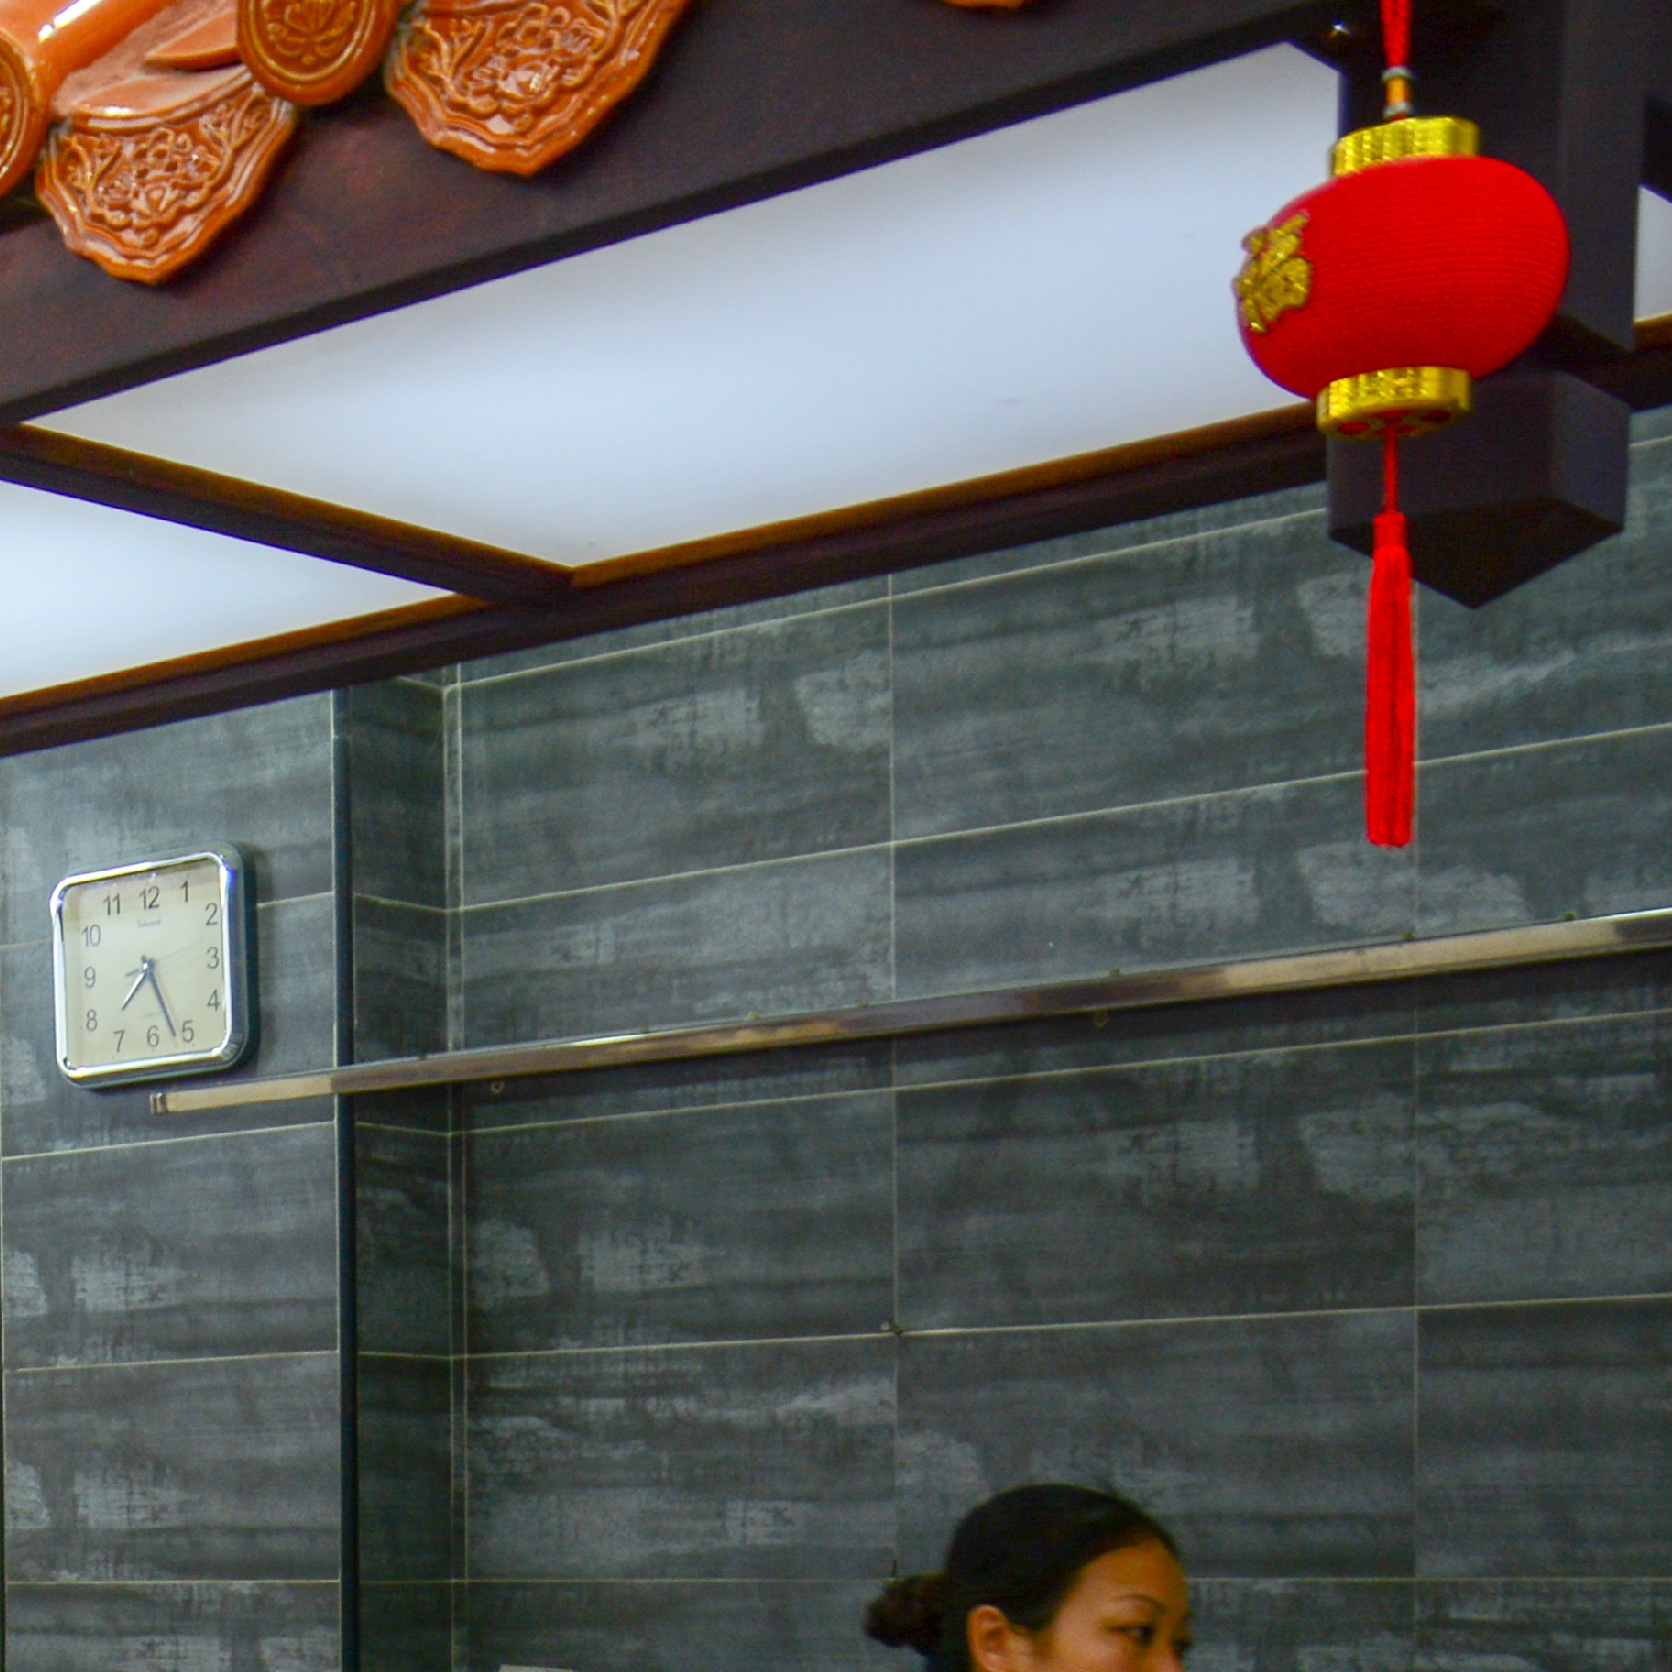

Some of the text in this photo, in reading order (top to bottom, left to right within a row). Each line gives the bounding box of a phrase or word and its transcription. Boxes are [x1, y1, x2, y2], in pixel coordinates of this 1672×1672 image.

[139, 886, 159, 910] 12
[181, 881, 189, 902] 1
[104, 893, 121, 915] 11
[206, 903, 218, 925] 2
[82, 925, 101, 947] 10
[207, 947, 219, 969] 3
[84, 967, 96, 988] 9
[207, 990, 220, 1011] 4
[87, 1010, 97, 1030] 8
[114, 1030, 125, 1052] 7
[147, 1025, 159, 1047] 6
[182, 1020, 194, 1043] 5
